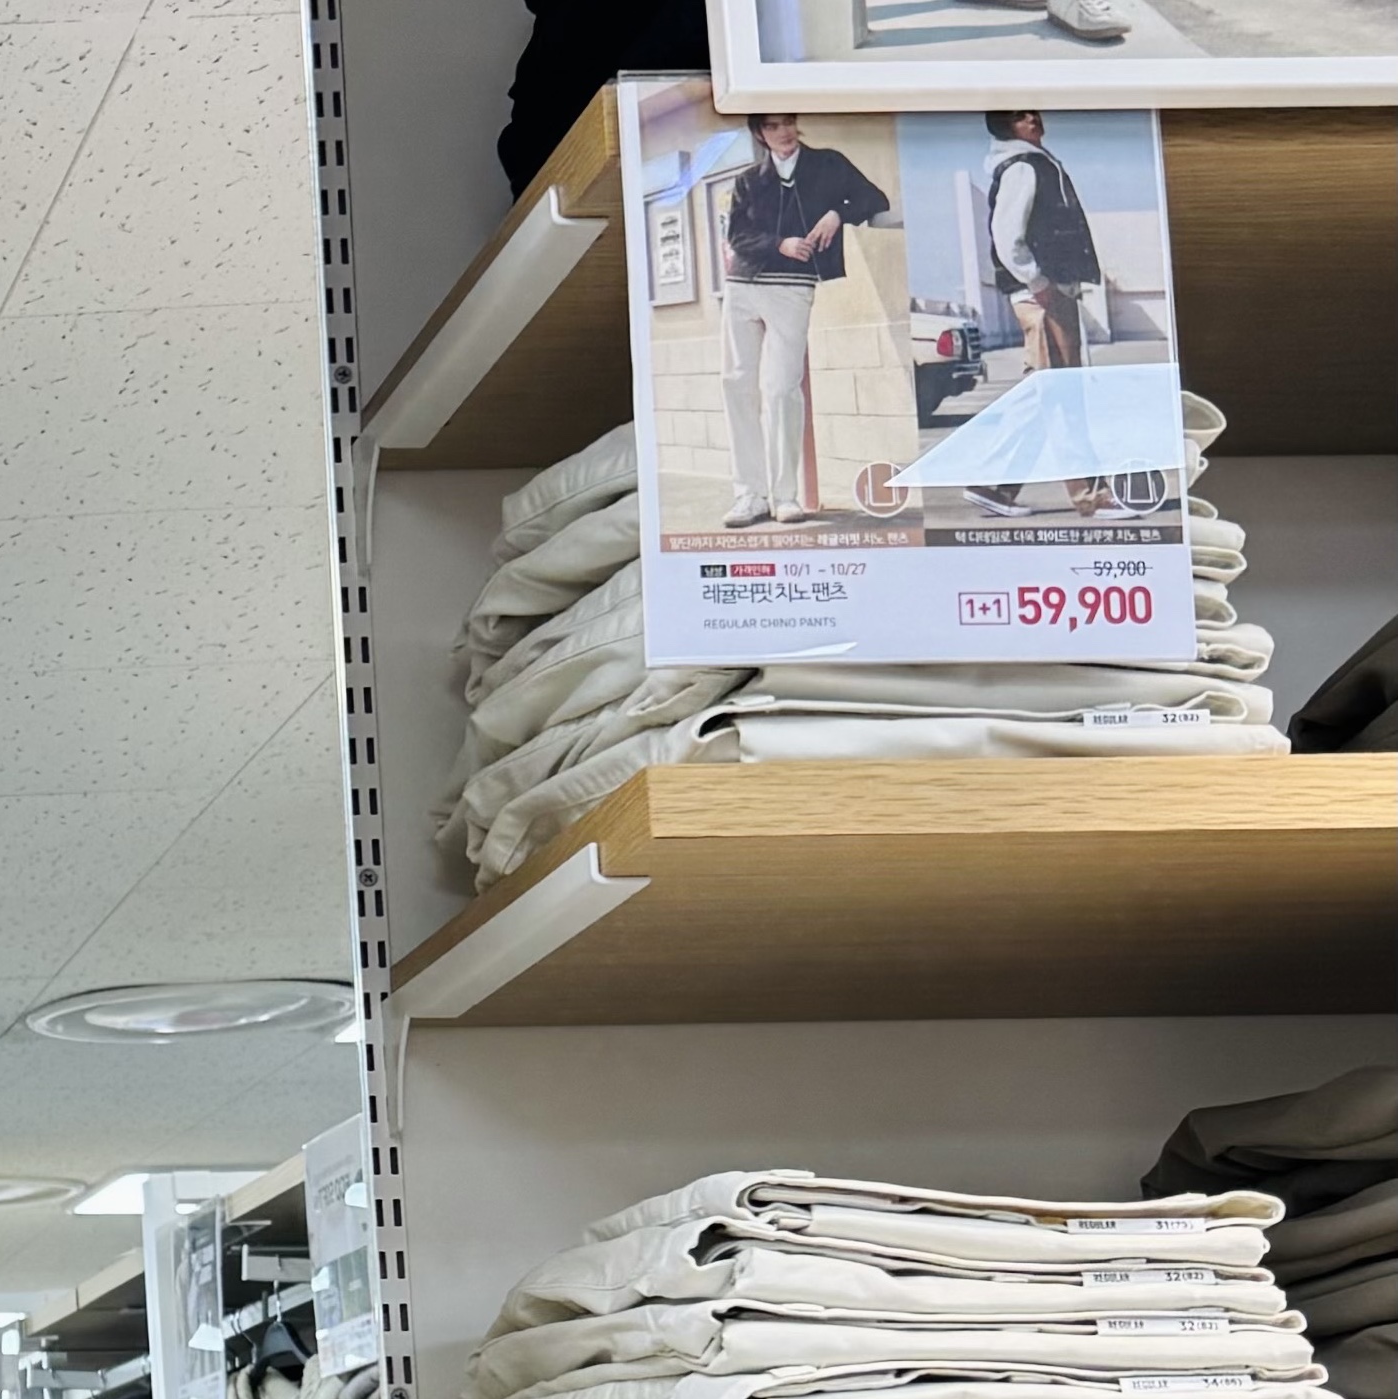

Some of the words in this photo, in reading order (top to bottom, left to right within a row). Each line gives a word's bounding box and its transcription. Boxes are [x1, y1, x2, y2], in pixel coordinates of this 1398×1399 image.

[862, 533, 885, 546] 치노
[887, 532, 910, 545] 팬츠
[1115, 528, 1138, 542] 치노
[1139, 528, 1163, 542] 팬츠
[783, 563, 811, 576] 10/1
[830, 562, 867, 576] 10/27
[1093, 560, 1146, 579] 59,900
[702, 582, 773, 605] 레귤러핏
[774, 581, 809, 603] 치노
[810, 580, 849, 602] 팬츠
[964, 597, 1003, 619] 1+1
[1016, 585, 1153, 633] 59,900
[703, 618, 758, 630] REGULAR
[760, 617, 797, 629] CHINO
[799, 616, 837, 628] PANTS
[1093, 714, 1129, 725] REGULAR
